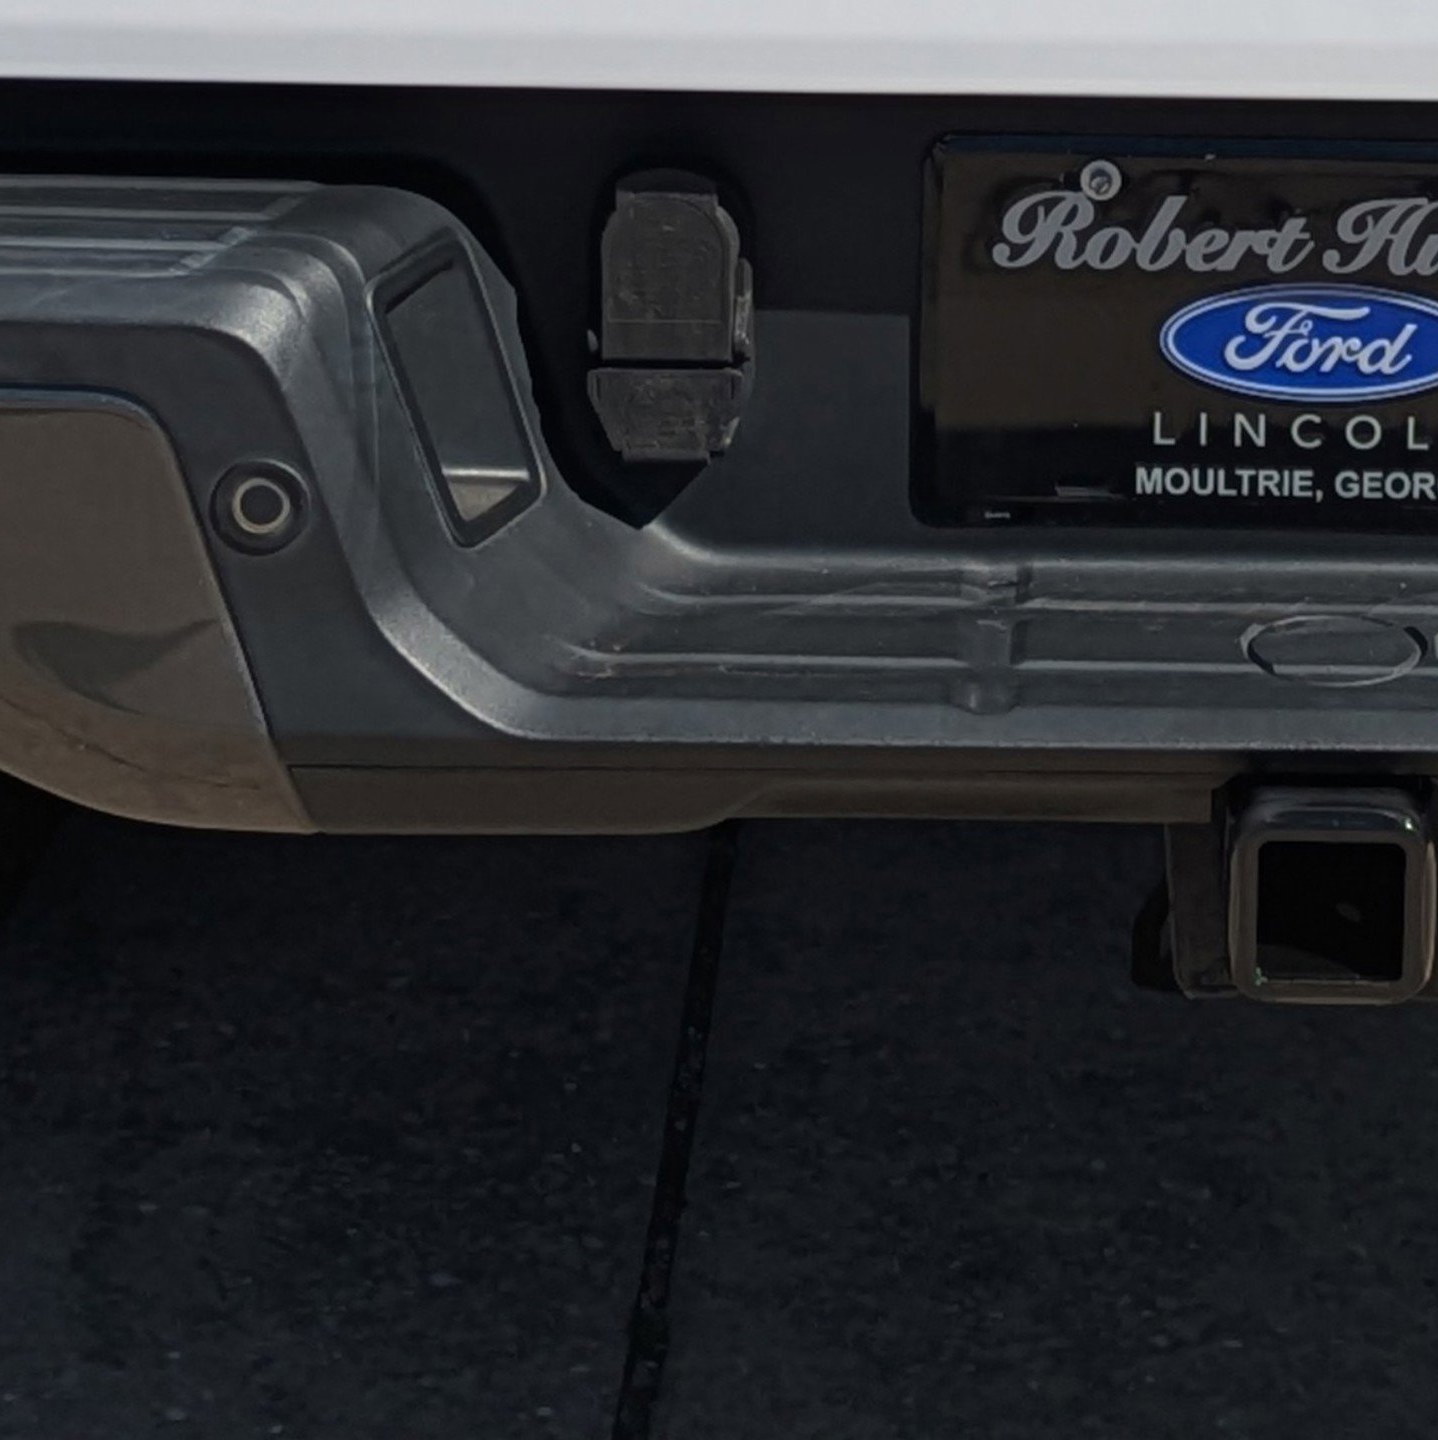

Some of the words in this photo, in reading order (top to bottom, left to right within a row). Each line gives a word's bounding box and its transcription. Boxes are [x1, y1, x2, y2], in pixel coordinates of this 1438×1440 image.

[992, 189, 1315, 274] Robert
[1224, 302, 1419, 375] Ford
[1135, 468, 1324, 502] MOULTRIE,
